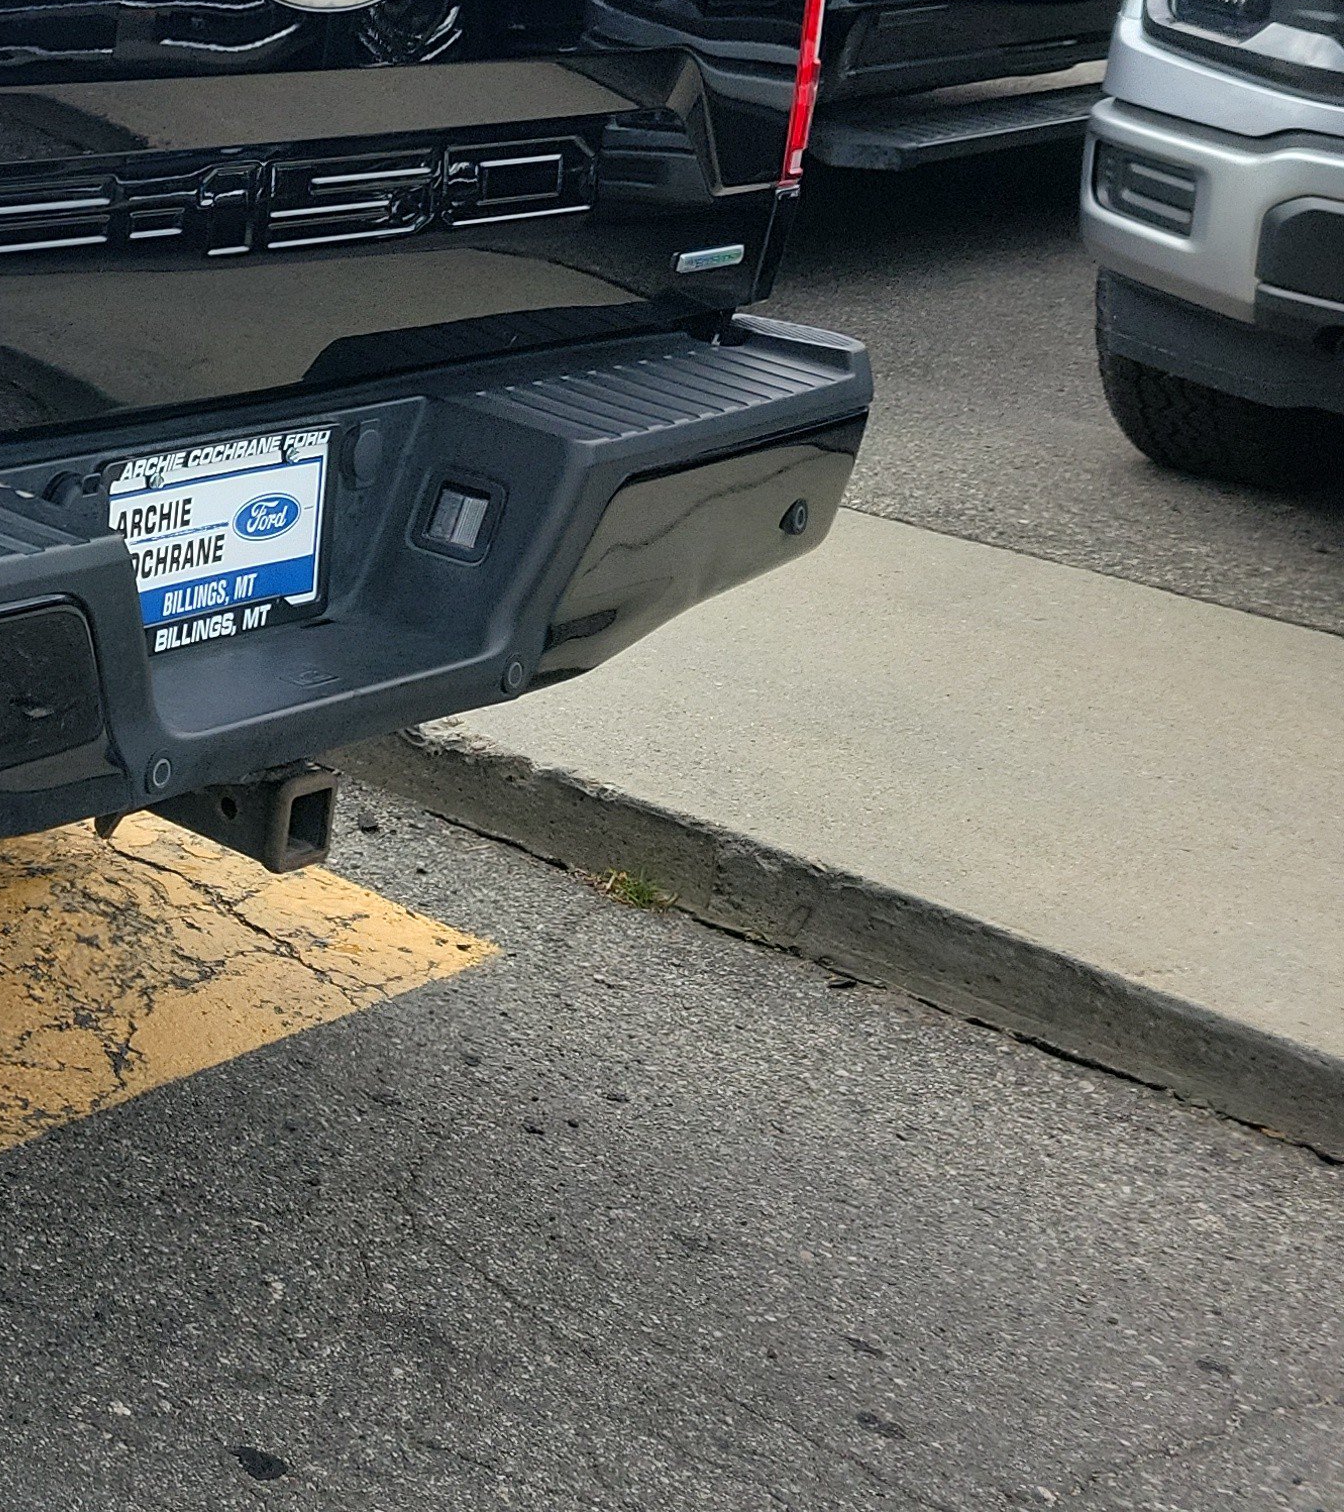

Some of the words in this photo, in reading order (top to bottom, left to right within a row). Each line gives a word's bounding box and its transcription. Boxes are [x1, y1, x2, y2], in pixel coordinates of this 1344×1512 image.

[120, 452, 184, 481] ARCHIE
[189, 435, 281, 466] COCHRANE
[283, 430, 331, 450] FORD
[117, 497, 192, 540] ARCHIE
[246, 503, 288, 533] Ford
[132, 533, 226, 580] OCHRANE
[162, 580, 229, 617] BILLINGS,
[235, 572, 257, 598] MT
[154, 615, 236, 653] BILLINGS,
[242, 604, 272, 630] MT
